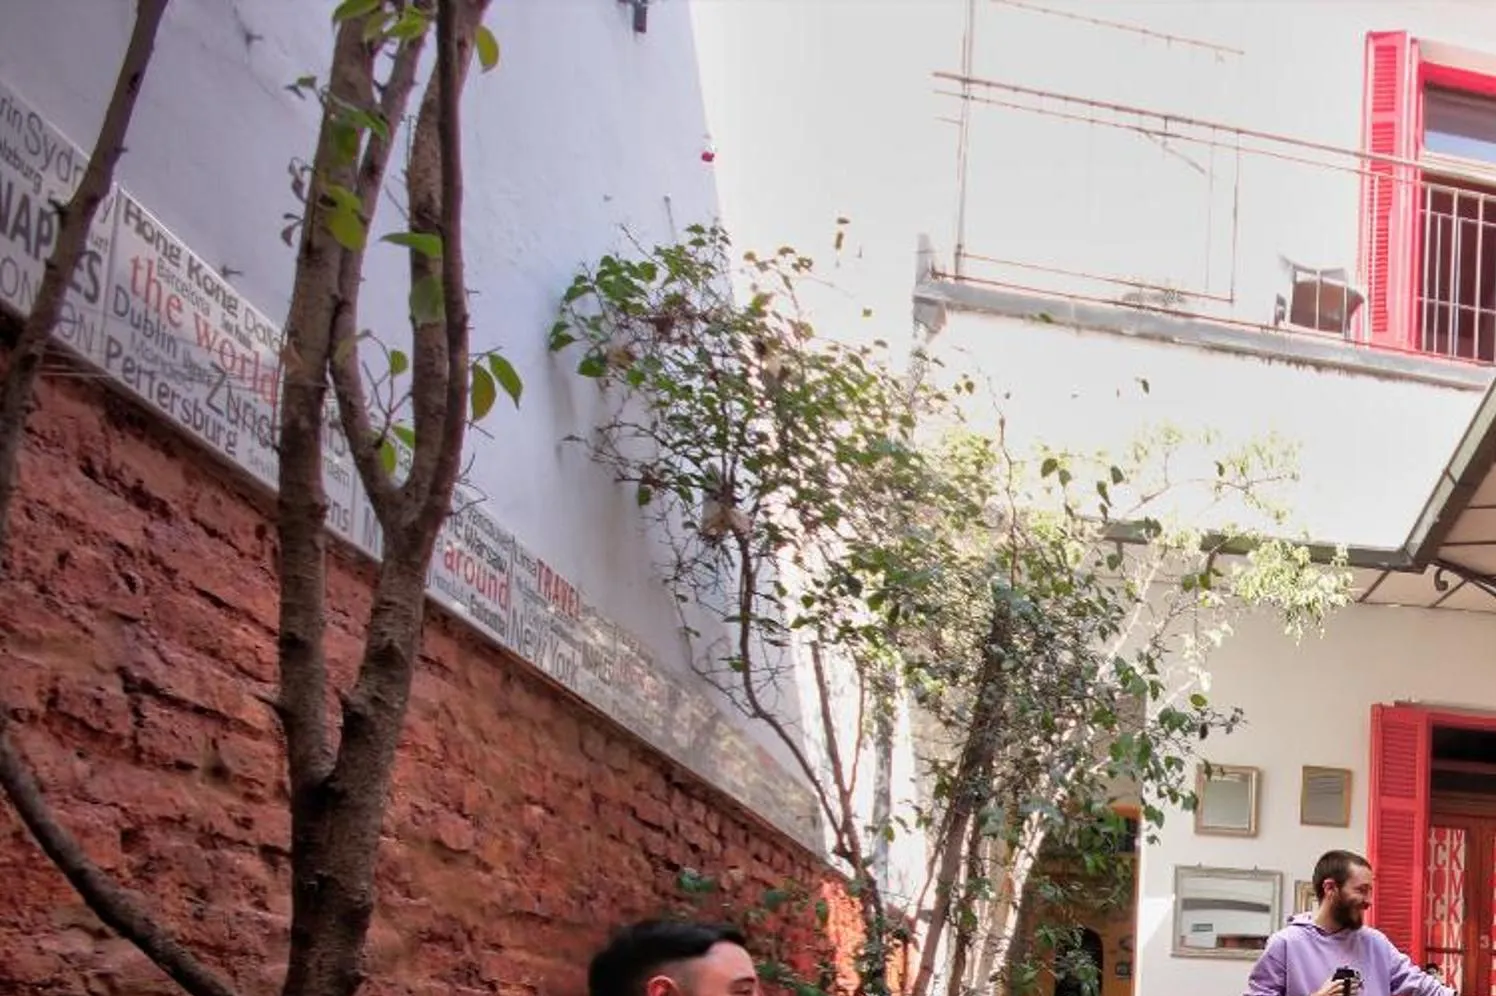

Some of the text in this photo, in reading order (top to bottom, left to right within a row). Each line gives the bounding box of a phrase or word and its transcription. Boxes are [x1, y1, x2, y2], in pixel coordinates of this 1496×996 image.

[124, 199, 181, 267] Hong
[187, 254, 239, 319] Kong
[113, 283, 177, 358] Dublin
[131, 254, 183, 330] the
[194, 311, 280, 407] world
[444, 543, 511, 613] around
[510, 604, 547, 668] New
